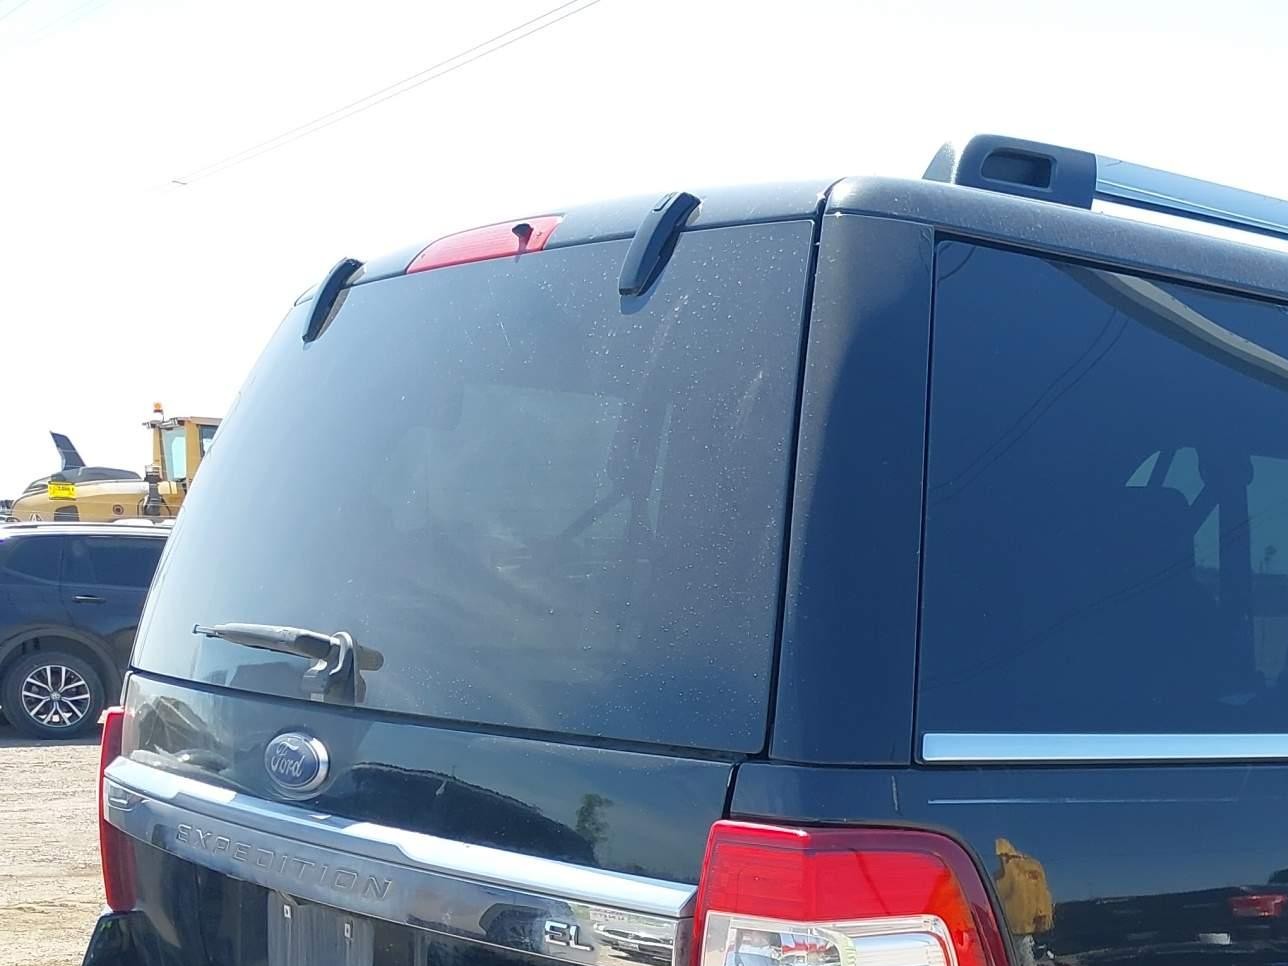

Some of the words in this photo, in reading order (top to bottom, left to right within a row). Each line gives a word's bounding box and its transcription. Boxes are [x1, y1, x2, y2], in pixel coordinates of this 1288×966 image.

[271, 741, 305, 777] Ford
[176, 823, 392, 899] EXPEDITION
[544, 919, 592, 951] EL
